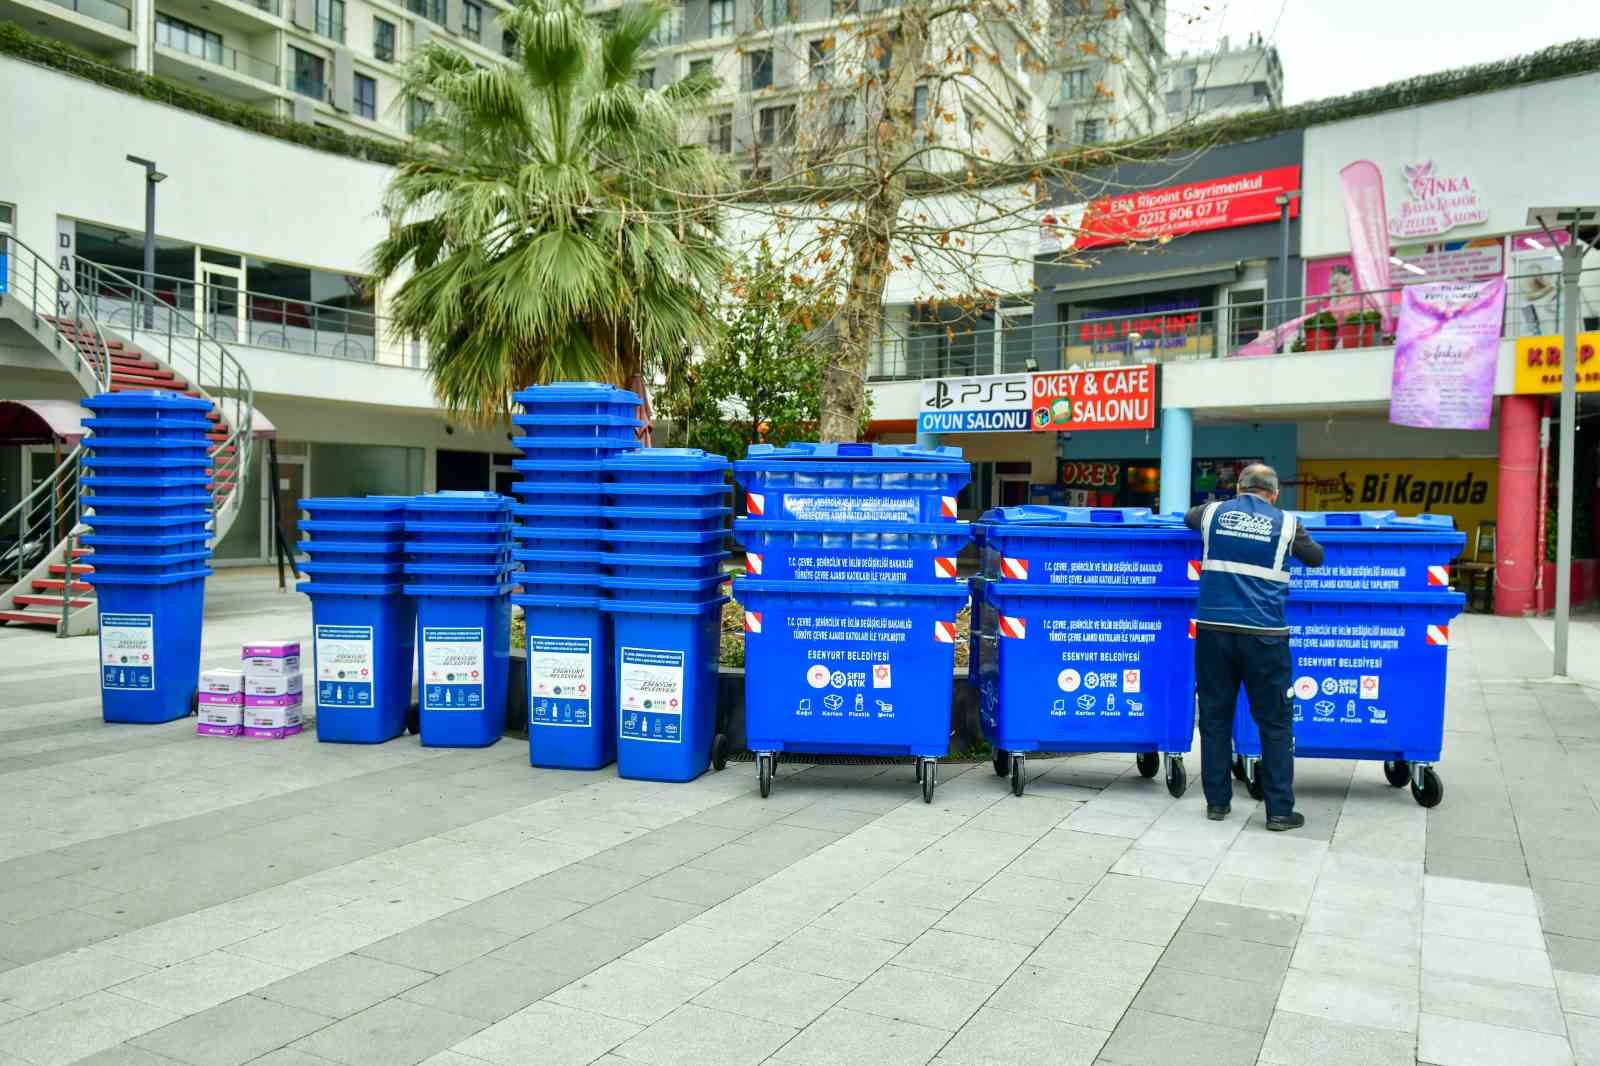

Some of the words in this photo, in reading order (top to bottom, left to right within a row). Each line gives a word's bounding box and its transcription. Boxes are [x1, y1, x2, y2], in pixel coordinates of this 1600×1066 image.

[1111, 198, 1135, 213] ERA
[1138, 191, 1179, 210] Ripoint
[1182, 176, 1263, 201] Gayrimenkul
[1421, 175, 1470, 199] ANKA
[1138, 210, 1166, 225] 0212
[1169, 205, 1194, 221] 806
[1196, 202, 1213, 217] 07
[1215, 200, 1229, 214] 17
[1527, 343, 1594, 368] KRP
[960, 381, 1027, 404] PS5
[1033, 375, 1080, 398] OKEY
[1084, 374, 1098, 396] &
[1102, 370, 1149, 394] CAFE
[923, 411, 964, 430] OYUN
[966, 411, 1028, 430] SALONU
[1072, 398, 1149, 423] SALONU
[1062, 462, 1120, 486] OKEY
[1360, 472, 1389, 503] Bi
[1391, 471, 1489, 512] Kapıda
[808, 650, 844, 660] ESENYURT
[847, 650, 889, 661] BELEDİYESİ
[1062, 652, 1097, 661] ESENYURT
[1100, 651, 1140, 661] BELEDİYESİ
[1298, 658, 1336, 667] ESENYURT
[847, 672, 865, 680] SIFIR
